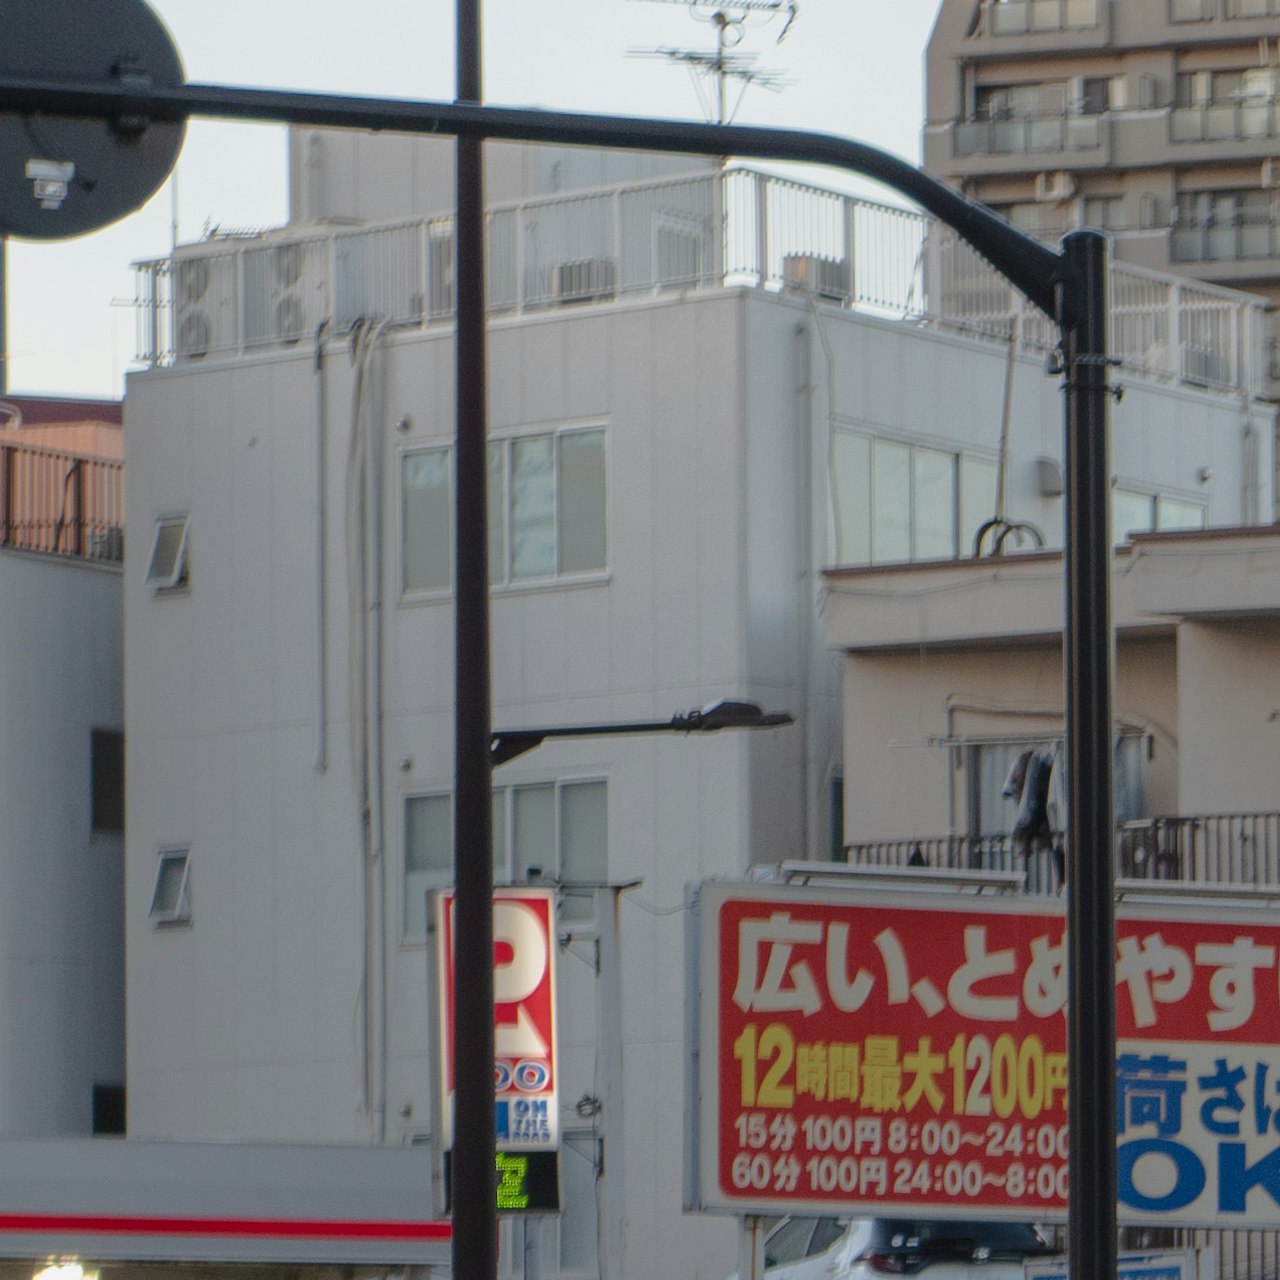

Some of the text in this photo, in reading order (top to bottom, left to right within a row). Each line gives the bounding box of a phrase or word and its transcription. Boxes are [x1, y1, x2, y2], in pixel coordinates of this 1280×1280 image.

[736, 1114, 797, 1152] 15分
[803, 1116, 883, 1154] 100円
[732, 1156, 800, 1192] 60分
[806, 1158, 888, 1195] 100円
